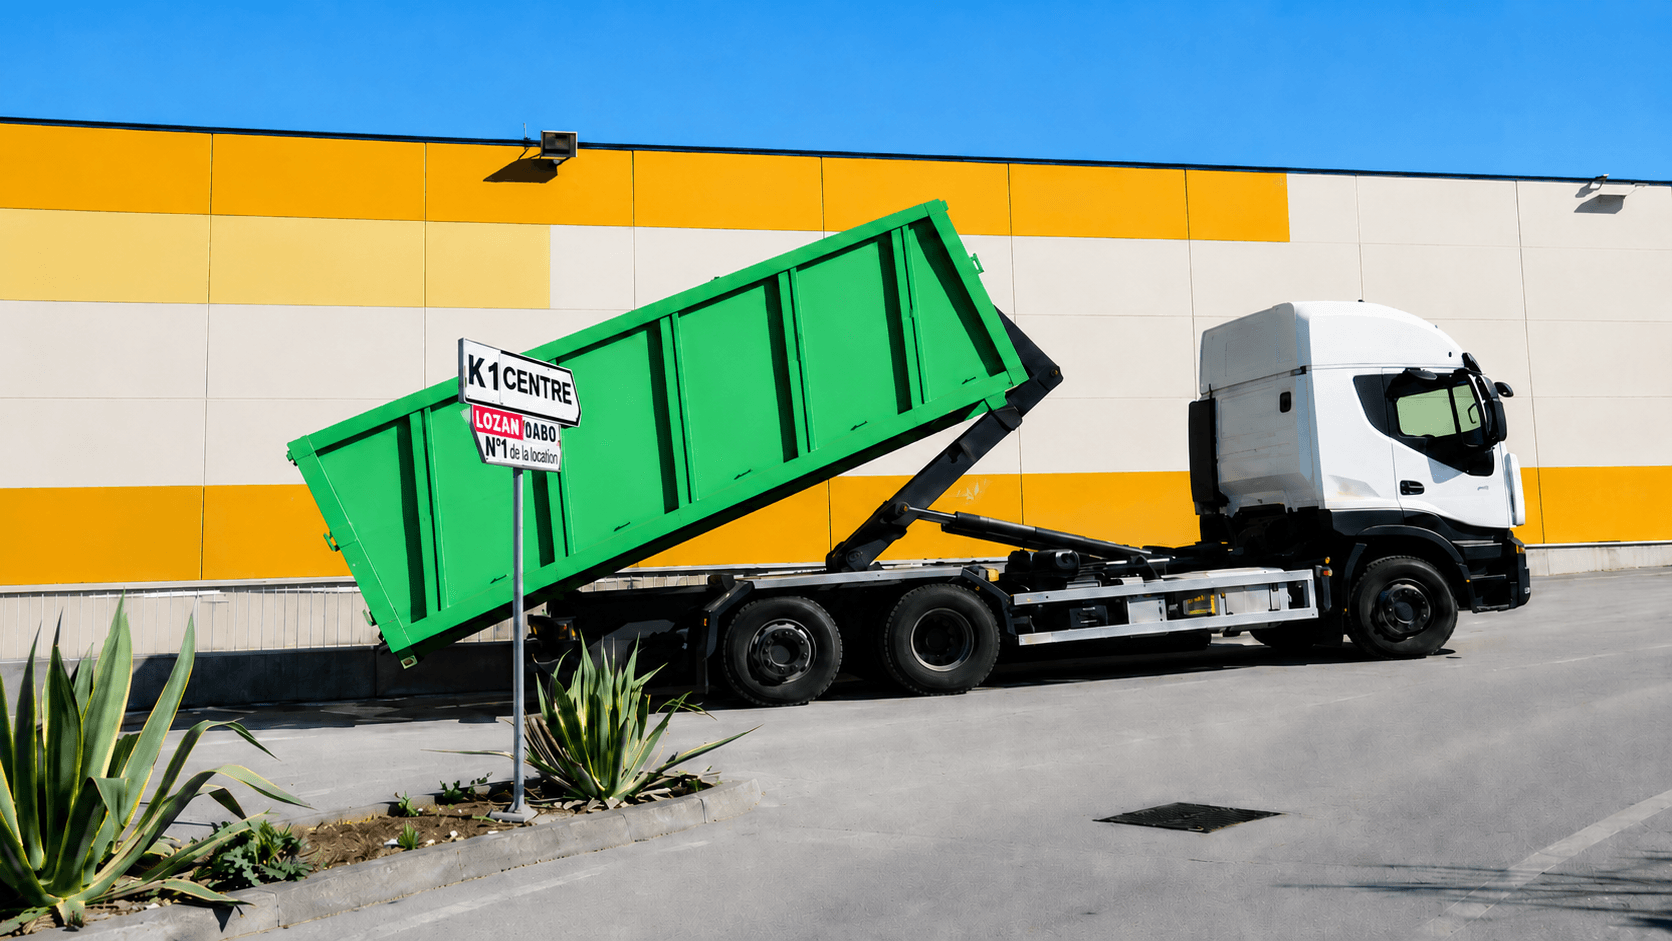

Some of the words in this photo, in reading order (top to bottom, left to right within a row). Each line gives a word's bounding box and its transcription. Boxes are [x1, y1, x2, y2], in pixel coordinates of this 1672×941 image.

[502, 366, 572, 405] CENTRE
[475, 410, 520, 436] LOZAN
[509, 443, 520, 460] de
[521, 445, 529, 461] la
[530, 447, 558, 465] location
